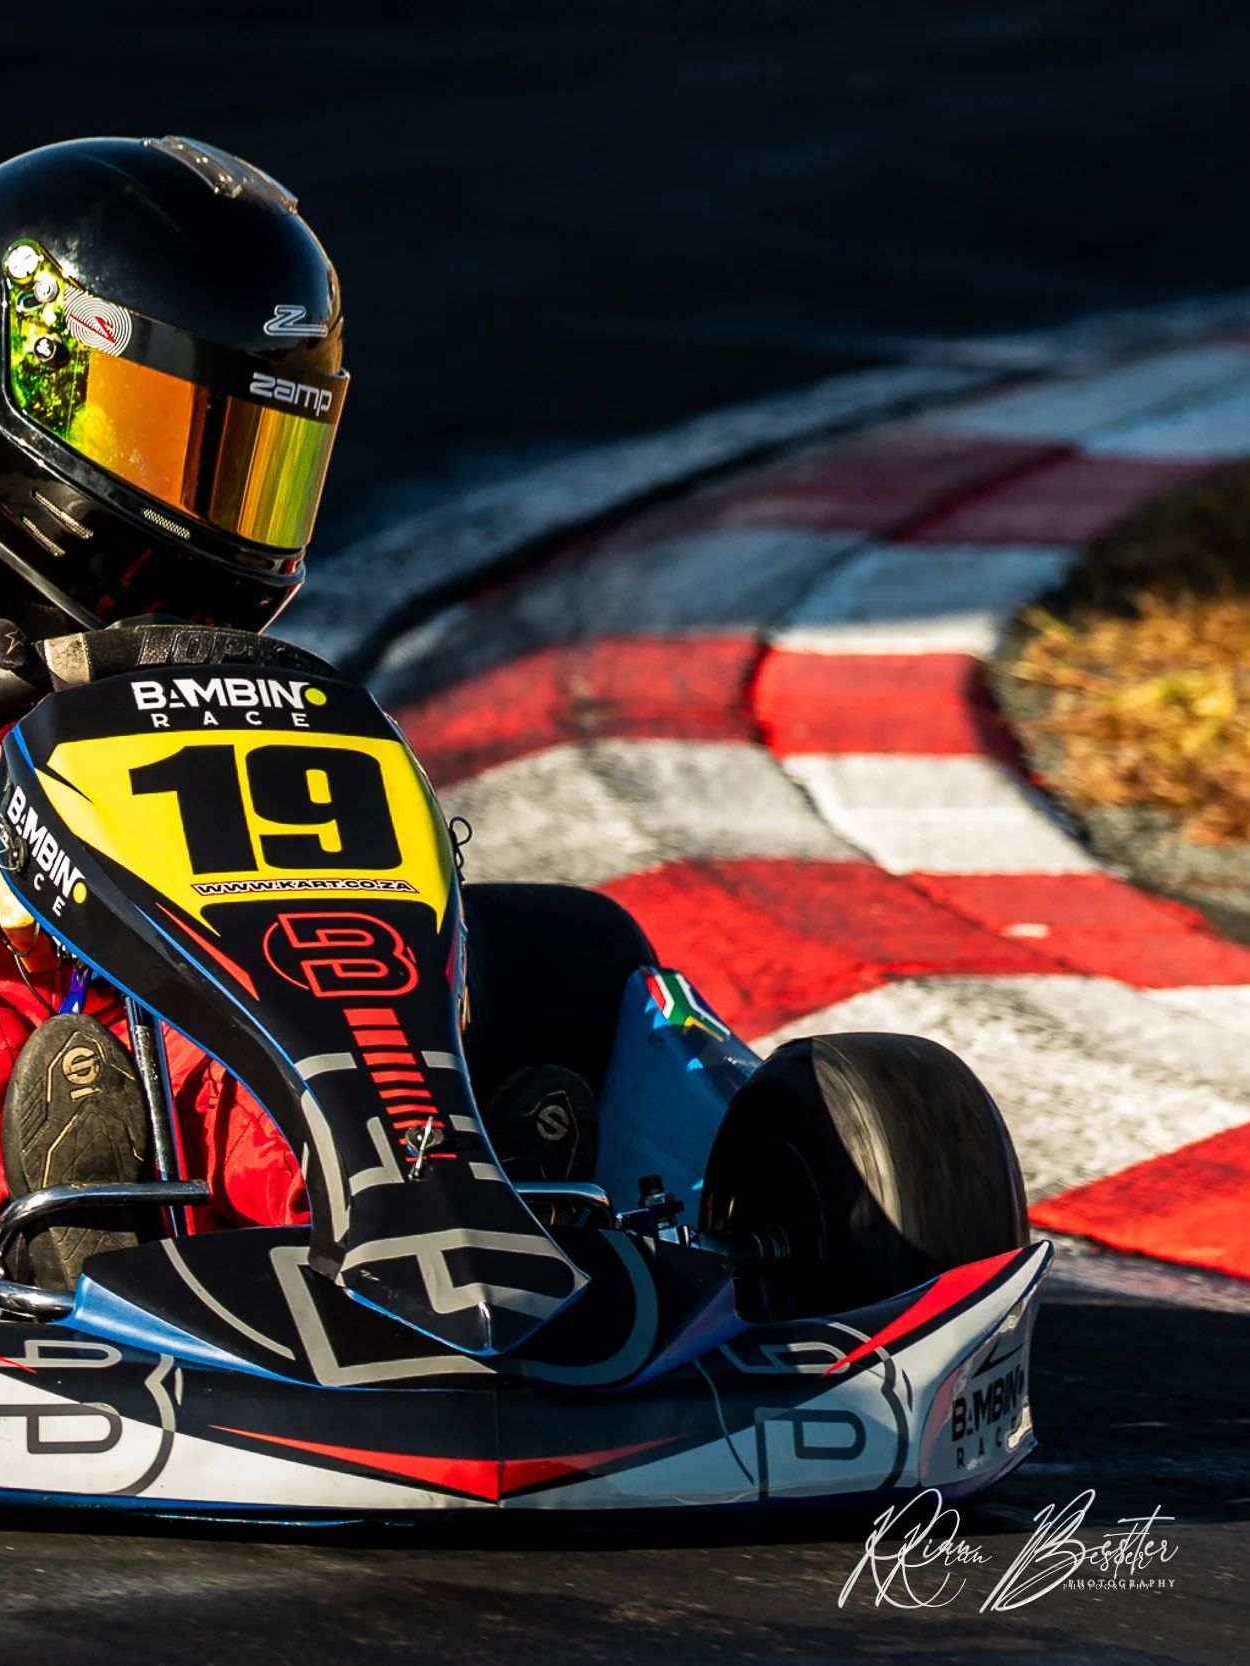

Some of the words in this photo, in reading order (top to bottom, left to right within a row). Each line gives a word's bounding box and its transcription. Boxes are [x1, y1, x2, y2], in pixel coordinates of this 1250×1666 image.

[249, 371, 333, 417] zamp
[152, 711, 311, 729] RACE
[127, 743, 403, 877] 19
[199, 880, 412, 895] WWW.KART.CO.ZA
